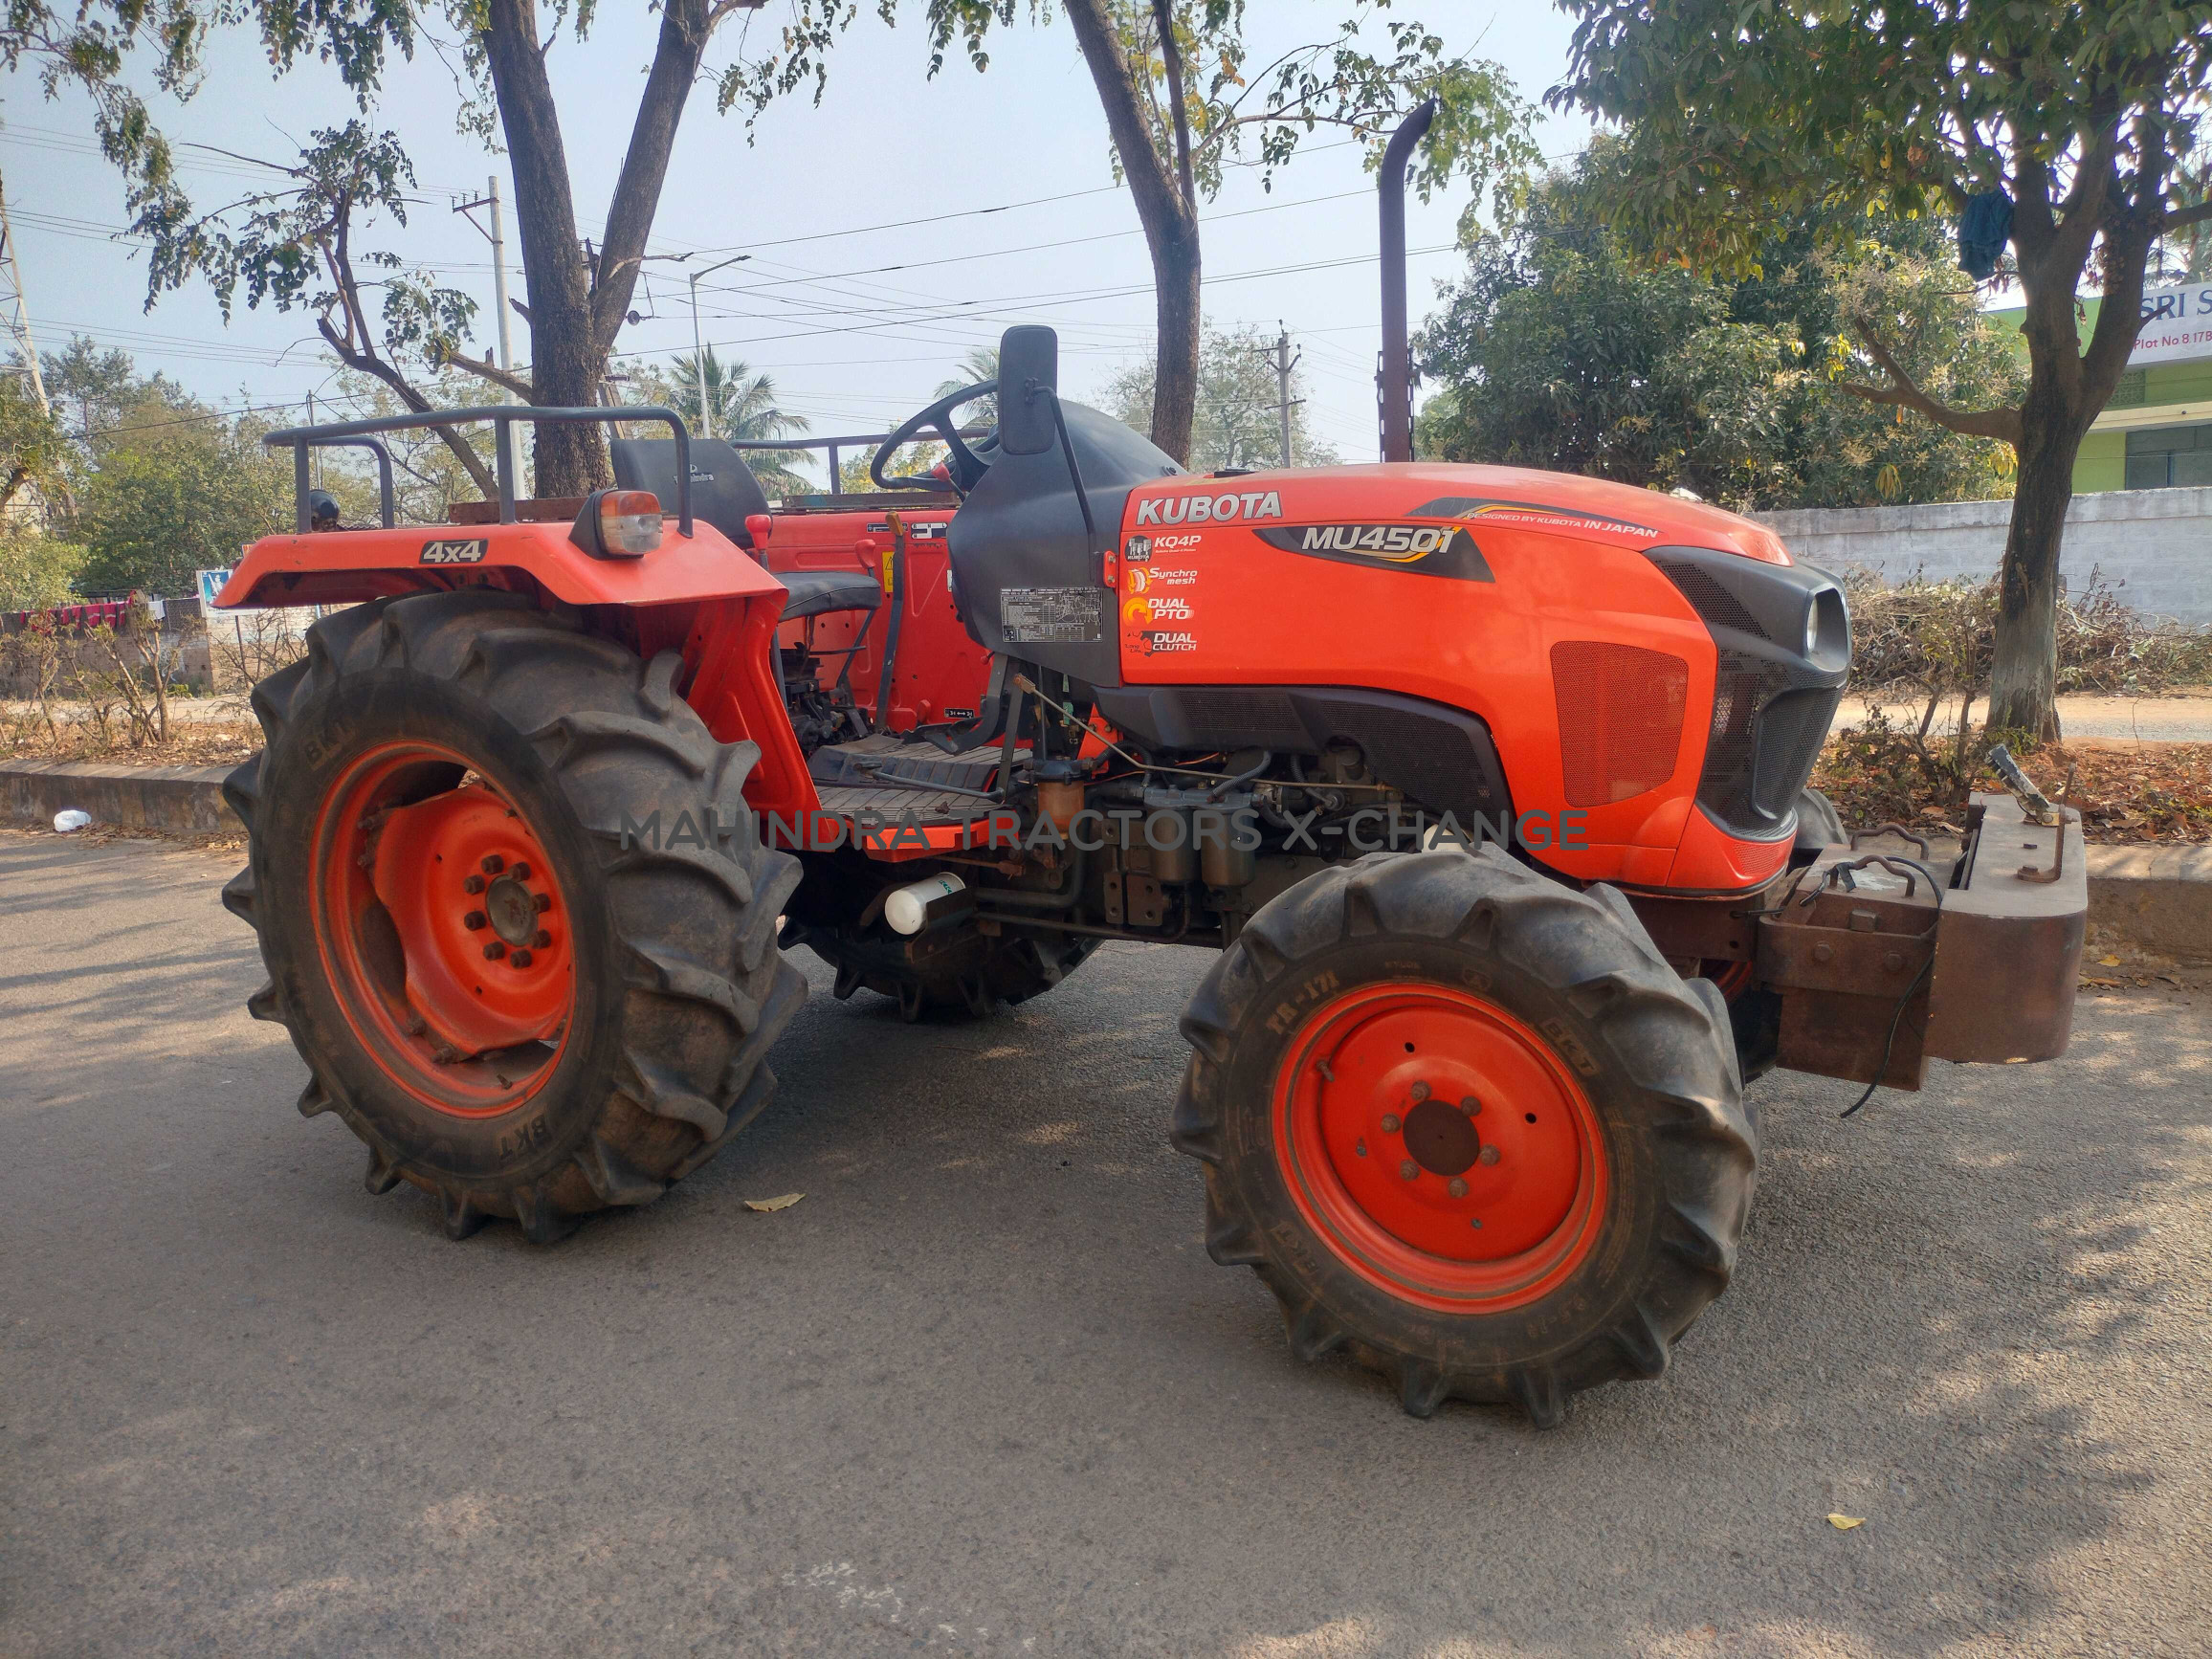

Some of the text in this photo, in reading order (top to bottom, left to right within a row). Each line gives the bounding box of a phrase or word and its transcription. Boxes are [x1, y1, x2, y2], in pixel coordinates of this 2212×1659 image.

[1137, 491, 1282, 525] KUBOTA
[1467, 512, 1521, 521] DESIGNED
[1536, 517, 1582, 527] KUBOTA
[1583, 520, 1603, 530] IN
[1601, 522, 1658, 539] JAPAN
[1155, 536, 1202, 548] KQ4P
[1301, 527, 1455, 554] MU4501
[423, 541, 481, 564] 4x4
[1148, 567, 1198, 580] Synchro
[1167, 577, 1196, 586] mesh
[1148, 598, 1189, 608] DUAL
[1154, 609, 1189, 620] PTO
[1153, 632, 1198, 643] DUAL
[1152, 643, 1197, 652] CLUTCH
[1542, 1021, 1597, 1073] BKT
